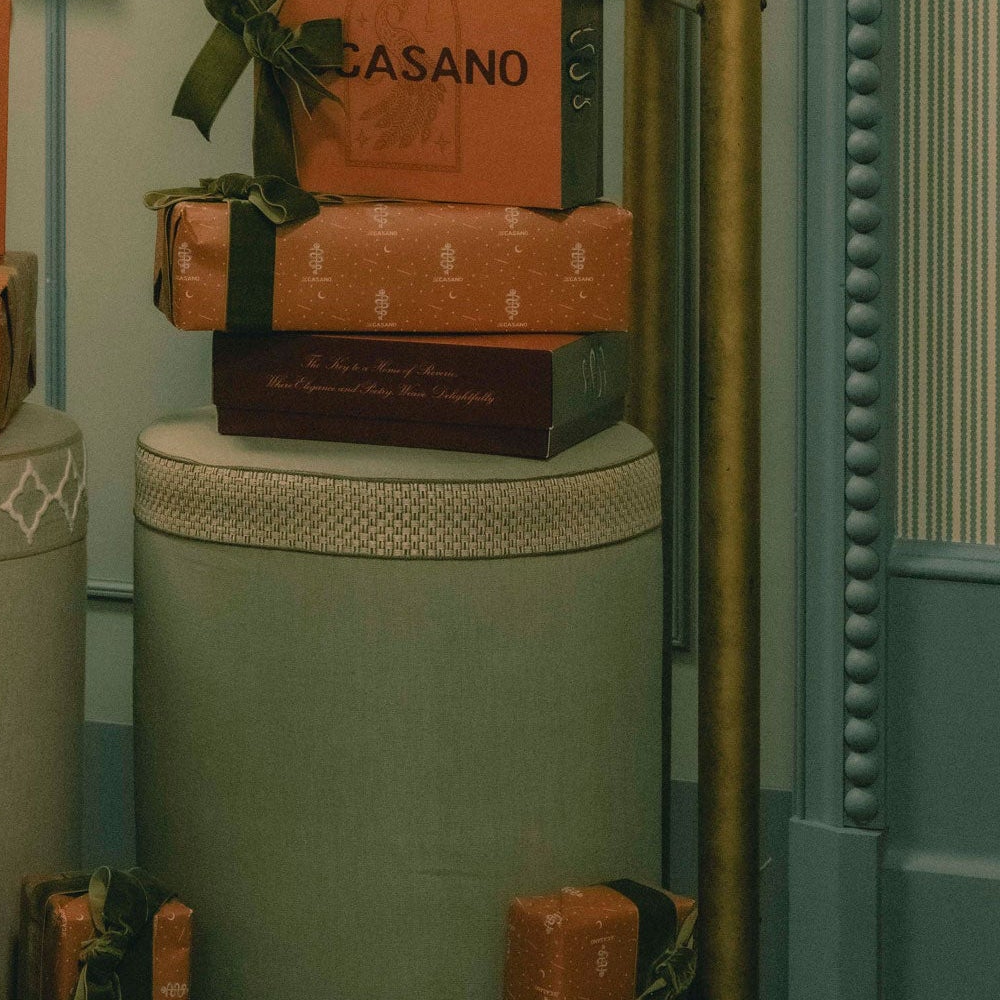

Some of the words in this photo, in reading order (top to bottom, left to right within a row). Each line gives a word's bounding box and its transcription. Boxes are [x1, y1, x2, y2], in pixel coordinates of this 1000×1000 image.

[301, 354, 322, 369] The
[402, 366, 416, 378] of
[337, 383, 361, 393] and
